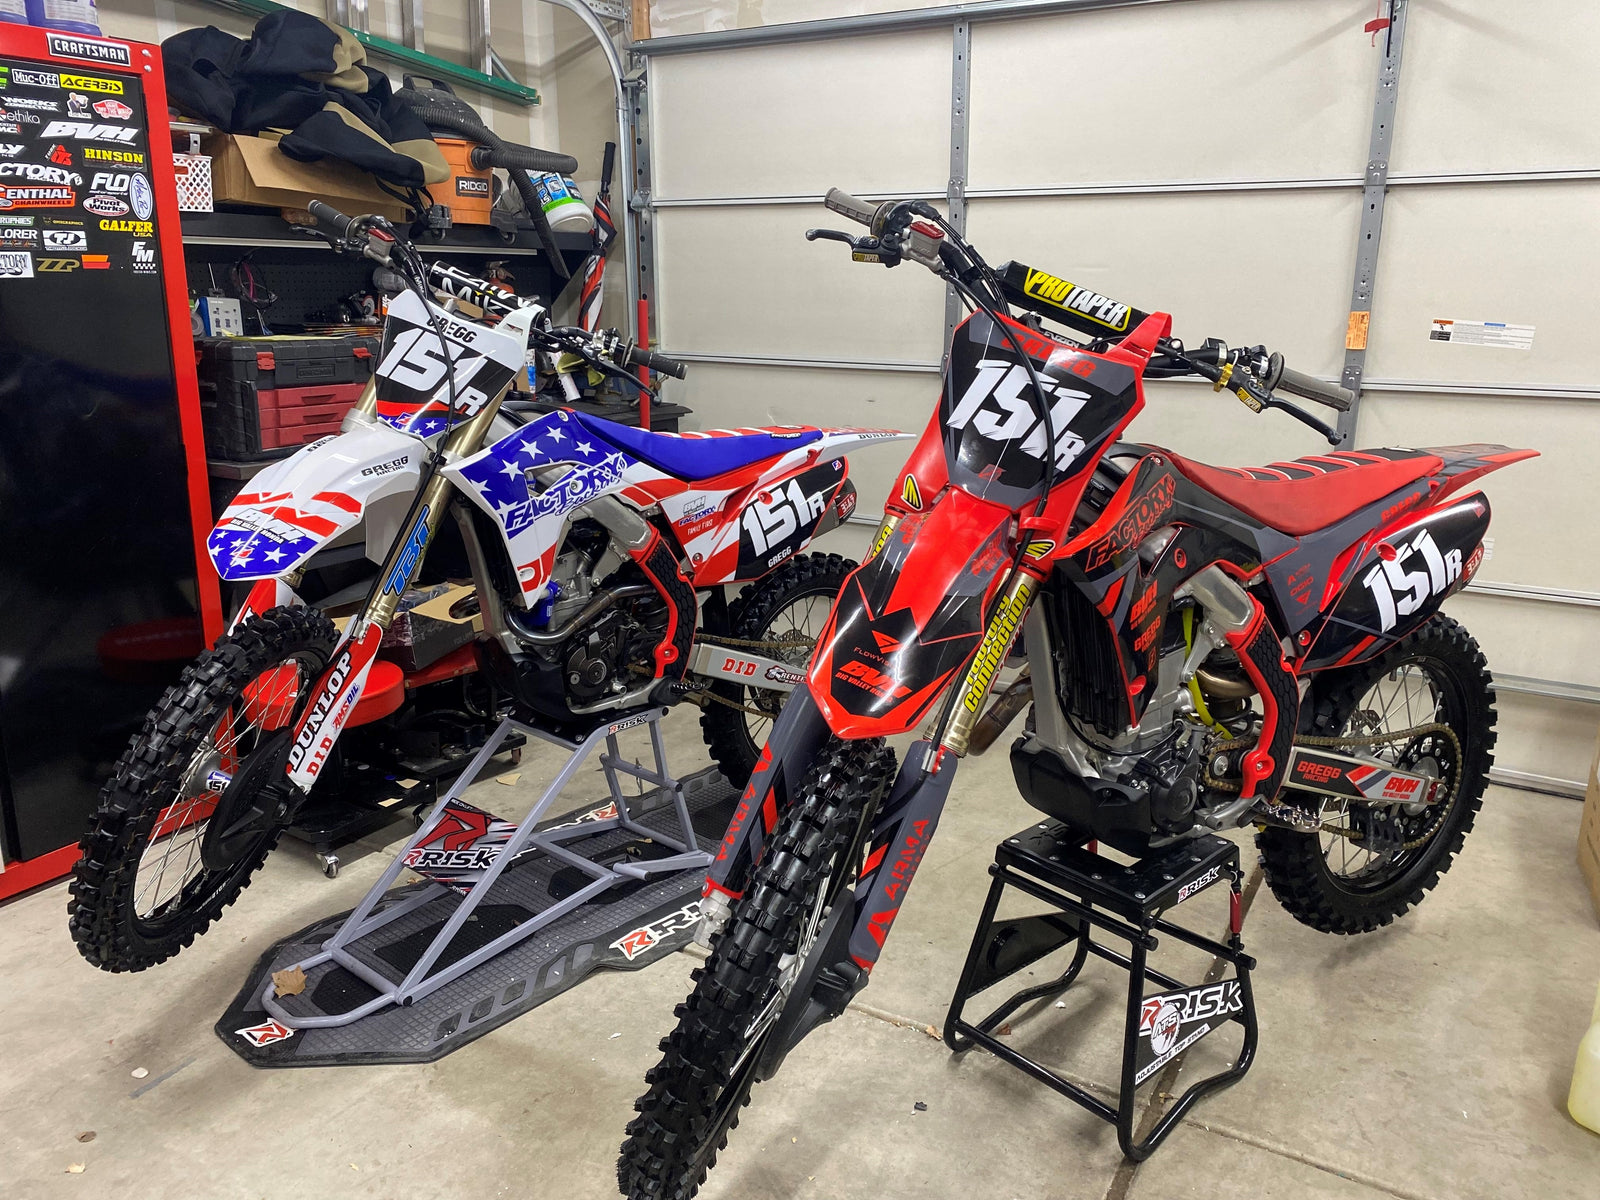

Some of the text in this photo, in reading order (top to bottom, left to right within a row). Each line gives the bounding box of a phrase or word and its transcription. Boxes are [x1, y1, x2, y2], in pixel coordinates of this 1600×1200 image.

[54, 39, 126, 61] CRAFTSMAN
[14, 71, 58, 86] Muc-Off
[62, 77, 122, 92] ACERBIS
[6, 109, 40, 124] ethika
[40, 121, 139, 141] BVH
[84, 148, 144, 164] HINSON
[459, 180, 488, 192] RIDGID
[89, 203, 126, 212] Works
[93, 198, 121, 206] Pivot
[99, 219, 154, 233] GALFER
[361, 455, 409, 477] GREGG
[505, 453, 622, 529] FACTORY
[1084, 472, 1177, 574] FACTORY
[768, 546, 792, 569] GREGG
[1130, 579, 1158, 624] BVH
[1134, 616, 1161, 652] GREGG
[963, 582, 1033, 714] Connection
[835, 671, 849, 681] BIG
[847, 676, 872, 691] VALLEY
[288, 650, 353, 773] DUNLOP
[1297, 760, 1342, 779] GREGG
[1302, 773, 1330, 784] RACING
[208, 780, 228, 792] 151
[1384, 776, 1421, 793] BVH
[418, 846, 502, 869] RISK
[884, 819, 930, 901] ARMA
[1185, 864, 1221, 896] RISK
[1162, 980, 1244, 1025] RISK
[1152, 1011, 1179, 1039] ATS
[1136, 1026, 1206, 1082] ADJUSTABLE TOP STAND
